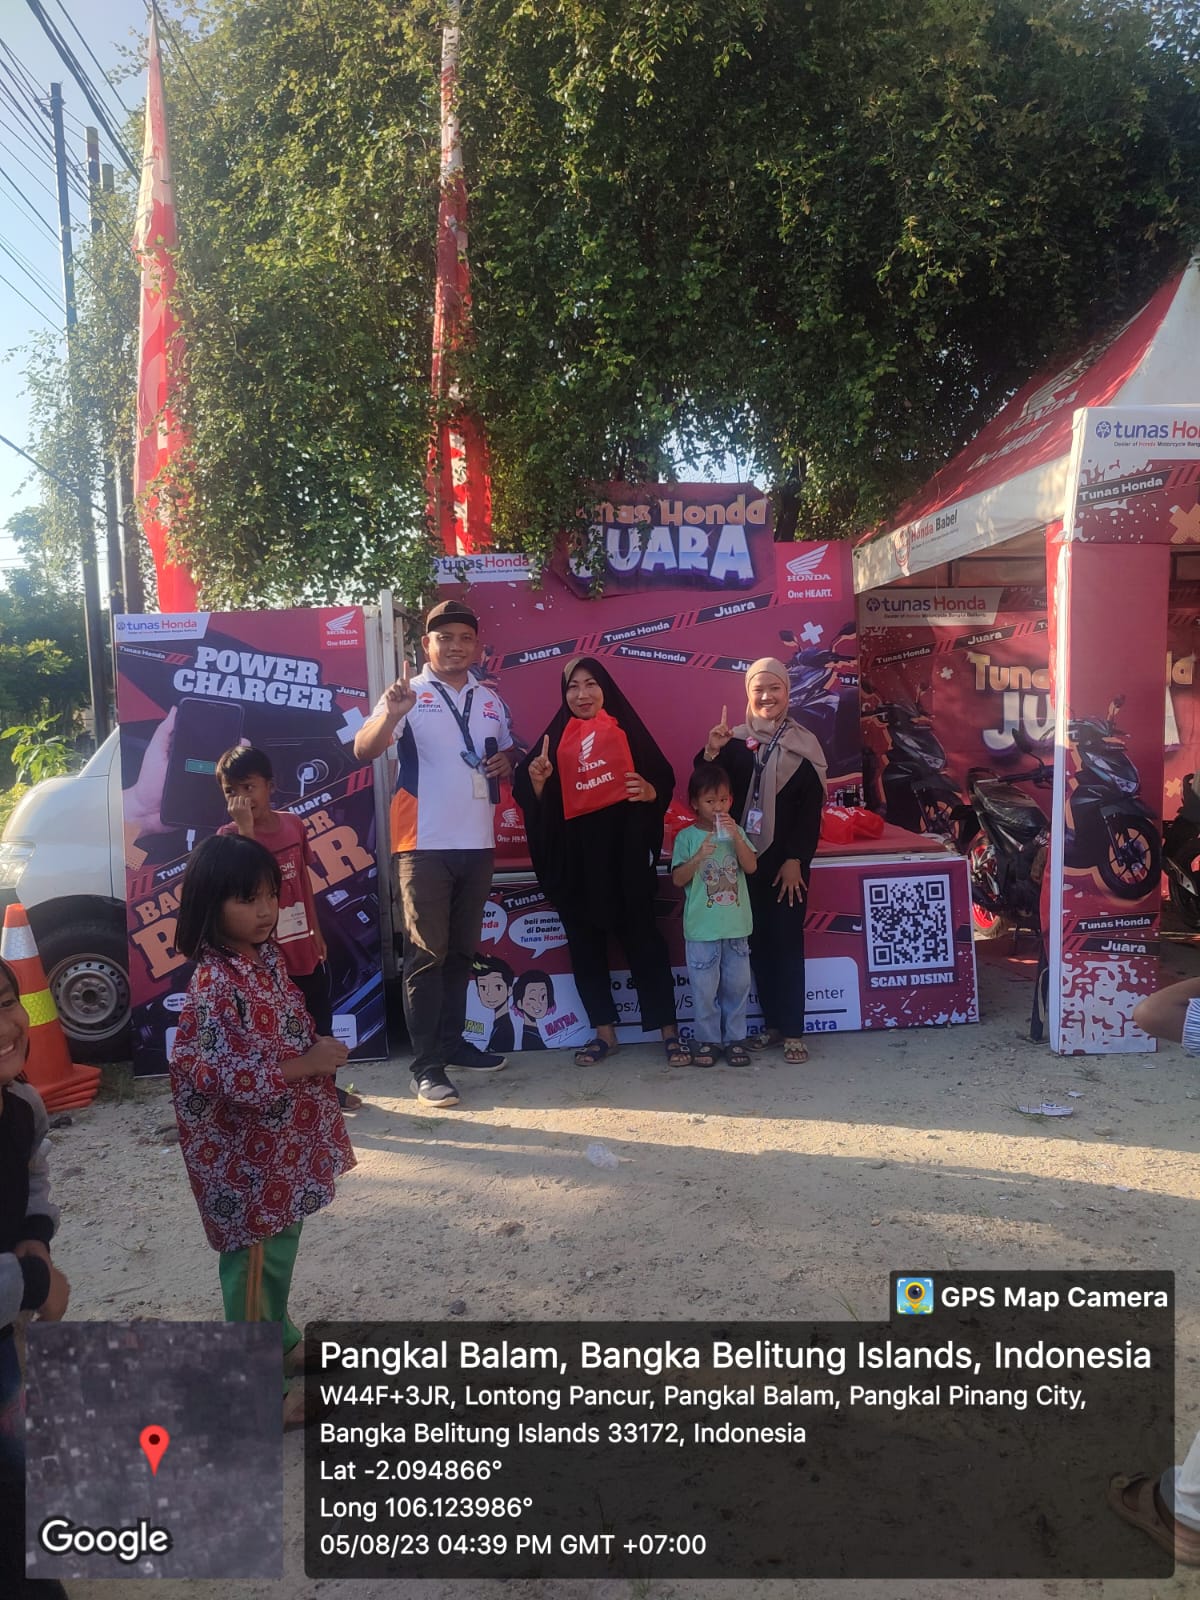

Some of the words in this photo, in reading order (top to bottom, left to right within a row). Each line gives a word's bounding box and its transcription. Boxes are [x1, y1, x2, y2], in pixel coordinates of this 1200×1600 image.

[1114, 420, 1169, 439] tunas
[1080, 487, 1119, 501] Tunas
[1121, 477, 1163, 493] Honda
[658, 494, 767, 526] Honda
[935, 508, 958, 532] Babel
[441, 558, 483, 570] tunas
[484, 555, 530, 568] Honda
[787, 574, 831, 582] HONDA
[787, 590, 804, 599] One
[714, 600, 756, 618] Juara
[883, 597, 931, 612] tunas
[934, 595, 987, 611] Honda
[126, 621, 161, 631] tunas
[161, 619, 198, 630] Honda
[604, 629, 637, 643] Tunas
[637, 621, 670, 635] Honda
[967, 631, 1003, 645] Juara
[519, 646, 562, 663] Juara
[620, 646, 652, 658] Tunas
[653, 650, 687, 663] Honda
[876, 654, 903, 665] Tunas
[903, 647, 931, 661] Honda
[194, 646, 320, 685] POWER
[173, 668, 333, 712] CHARGER
[336, 687, 366, 697] Juara
[504, 892, 546, 908] Tunas
[524, 917, 539, 925] beli
[1078, 920, 1114, 931] Tunas
[1115, 916, 1151, 929] Honda
[526, 926, 534, 934] di
[1101, 941, 1147, 954] Juara
[870, 975, 908, 988] SCAN
[910, 972, 955, 985] DISINI
